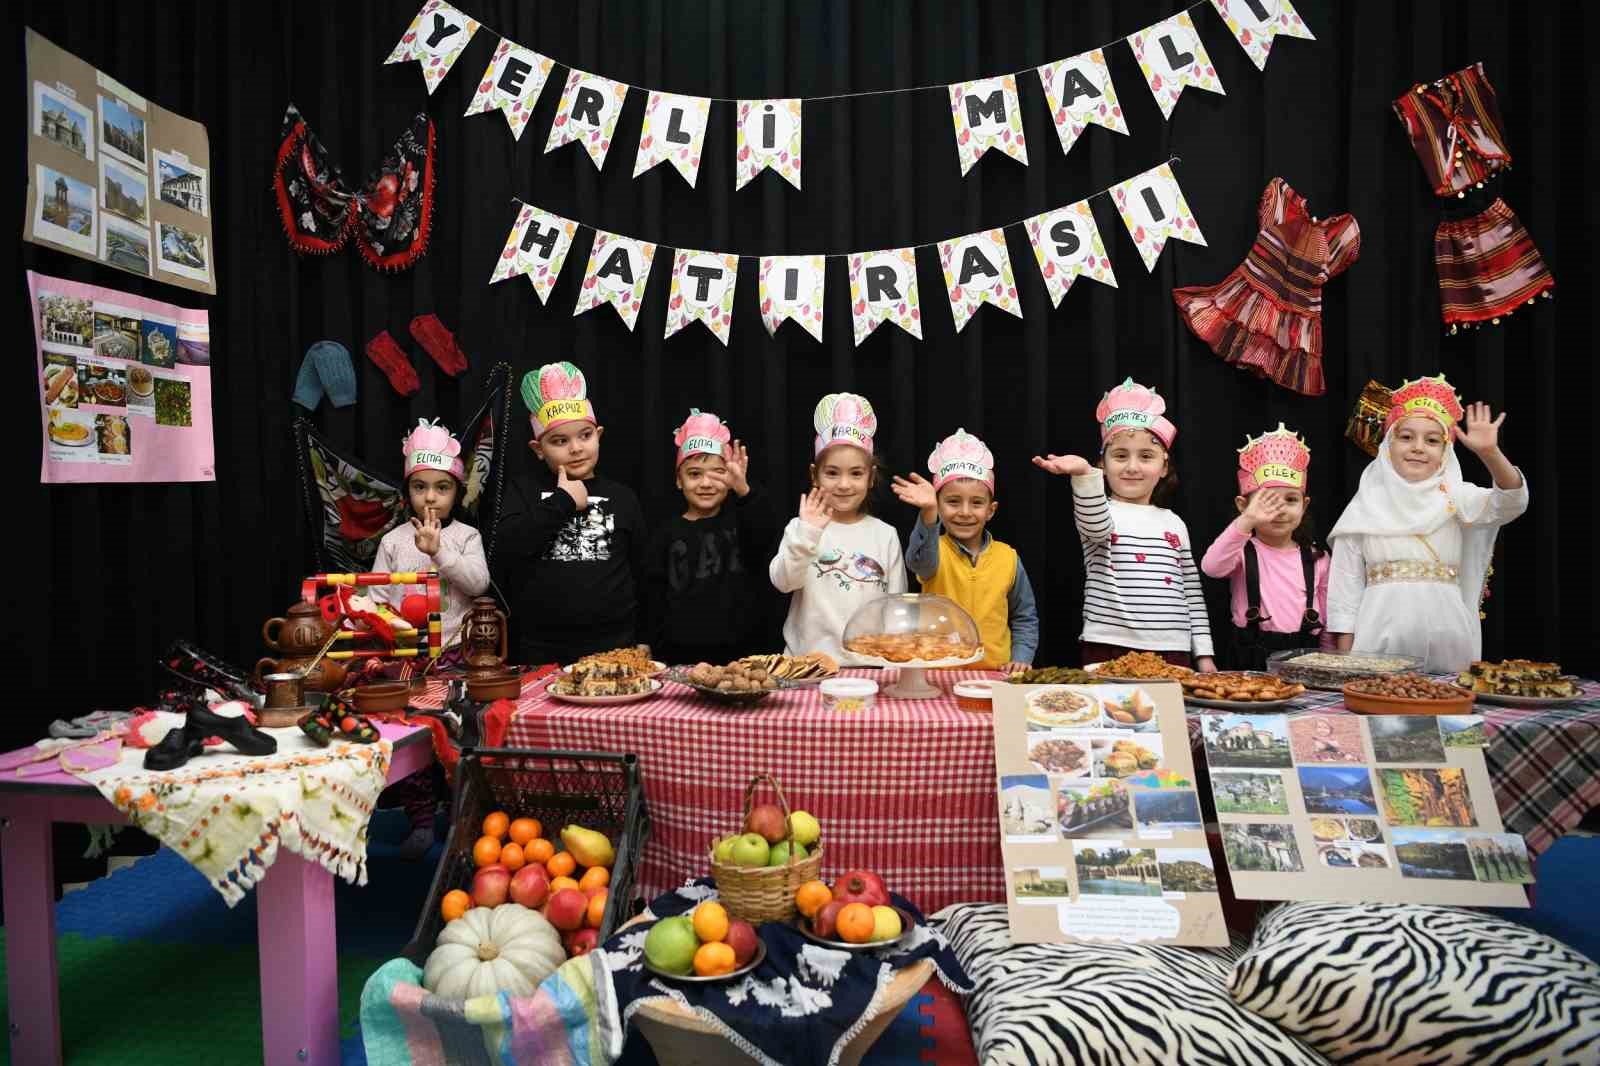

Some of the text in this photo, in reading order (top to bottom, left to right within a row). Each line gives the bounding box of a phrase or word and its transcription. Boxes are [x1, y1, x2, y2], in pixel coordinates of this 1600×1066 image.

[520, 187, 1167, 302] HATIRASI
[544, 402, 582, 420] KARPUZ
[832, 424, 865, 443] KARPUZ
[689, 439, 713, 450] ELMA
[416, 452, 442, 465] ELMA
[940, 462, 983, 477] DOMATES
